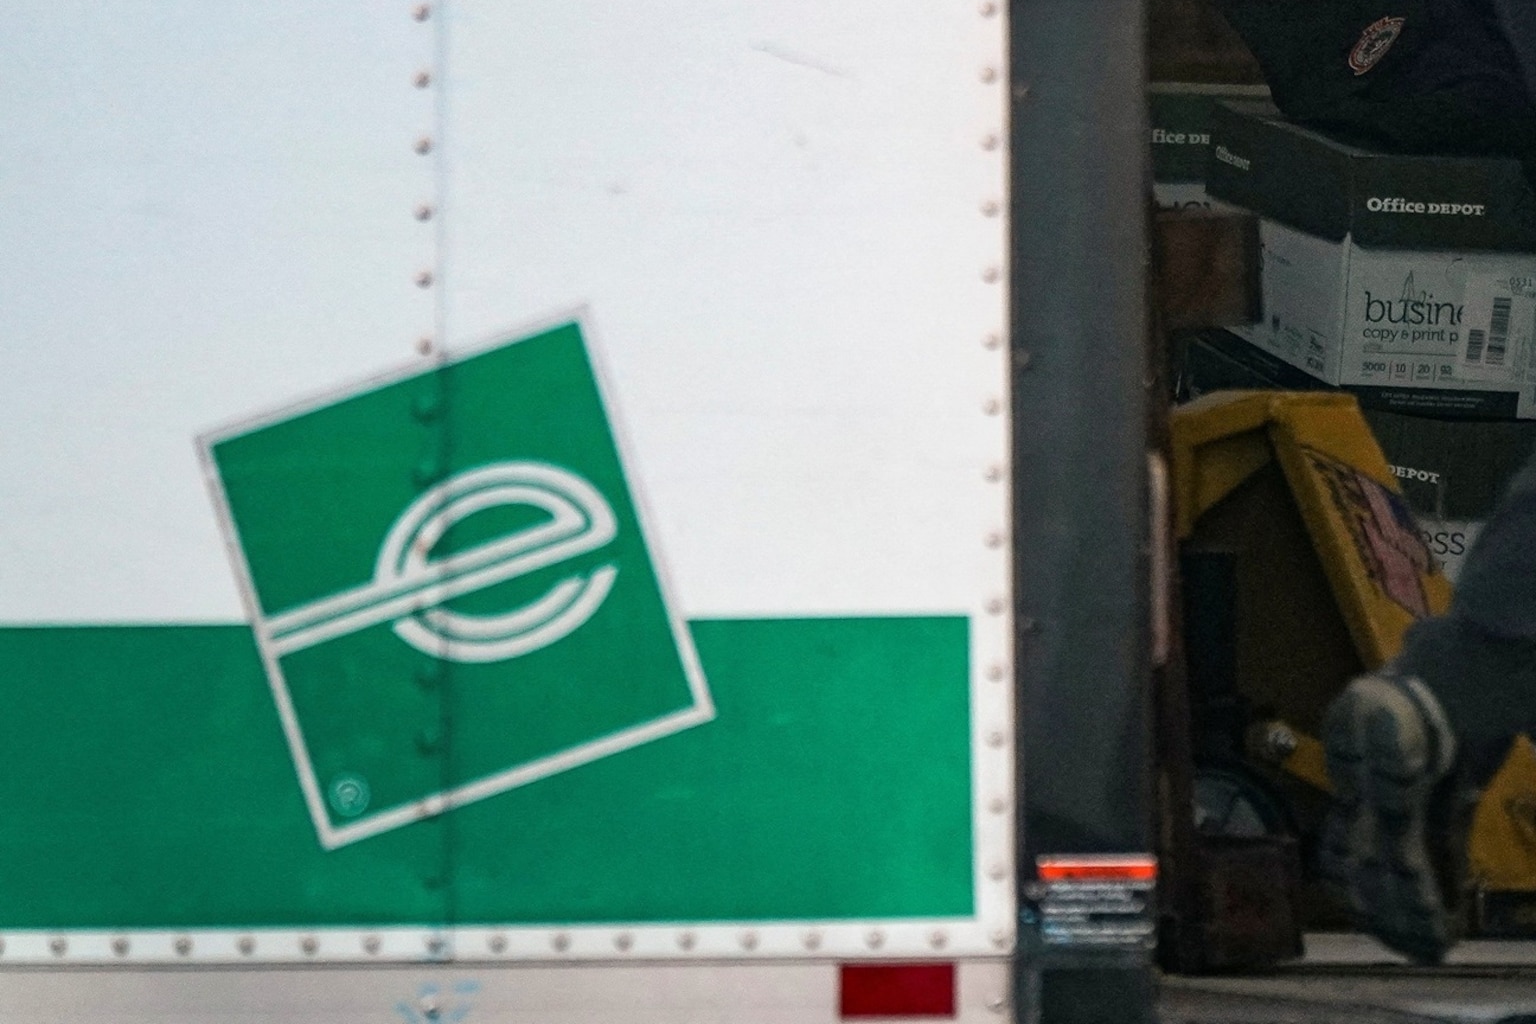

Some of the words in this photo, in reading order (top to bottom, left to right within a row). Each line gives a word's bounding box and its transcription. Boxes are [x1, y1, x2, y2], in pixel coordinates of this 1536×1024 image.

[1152, 128, 1186, 144] fice
[1187, 133, 1210, 145] DE
[1366, 197, 1425, 213] Office
[1427, 202, 1485, 216] DEPOT
[1362, 328, 1399, 343] copy
[1412, 327, 1446, 343] print
